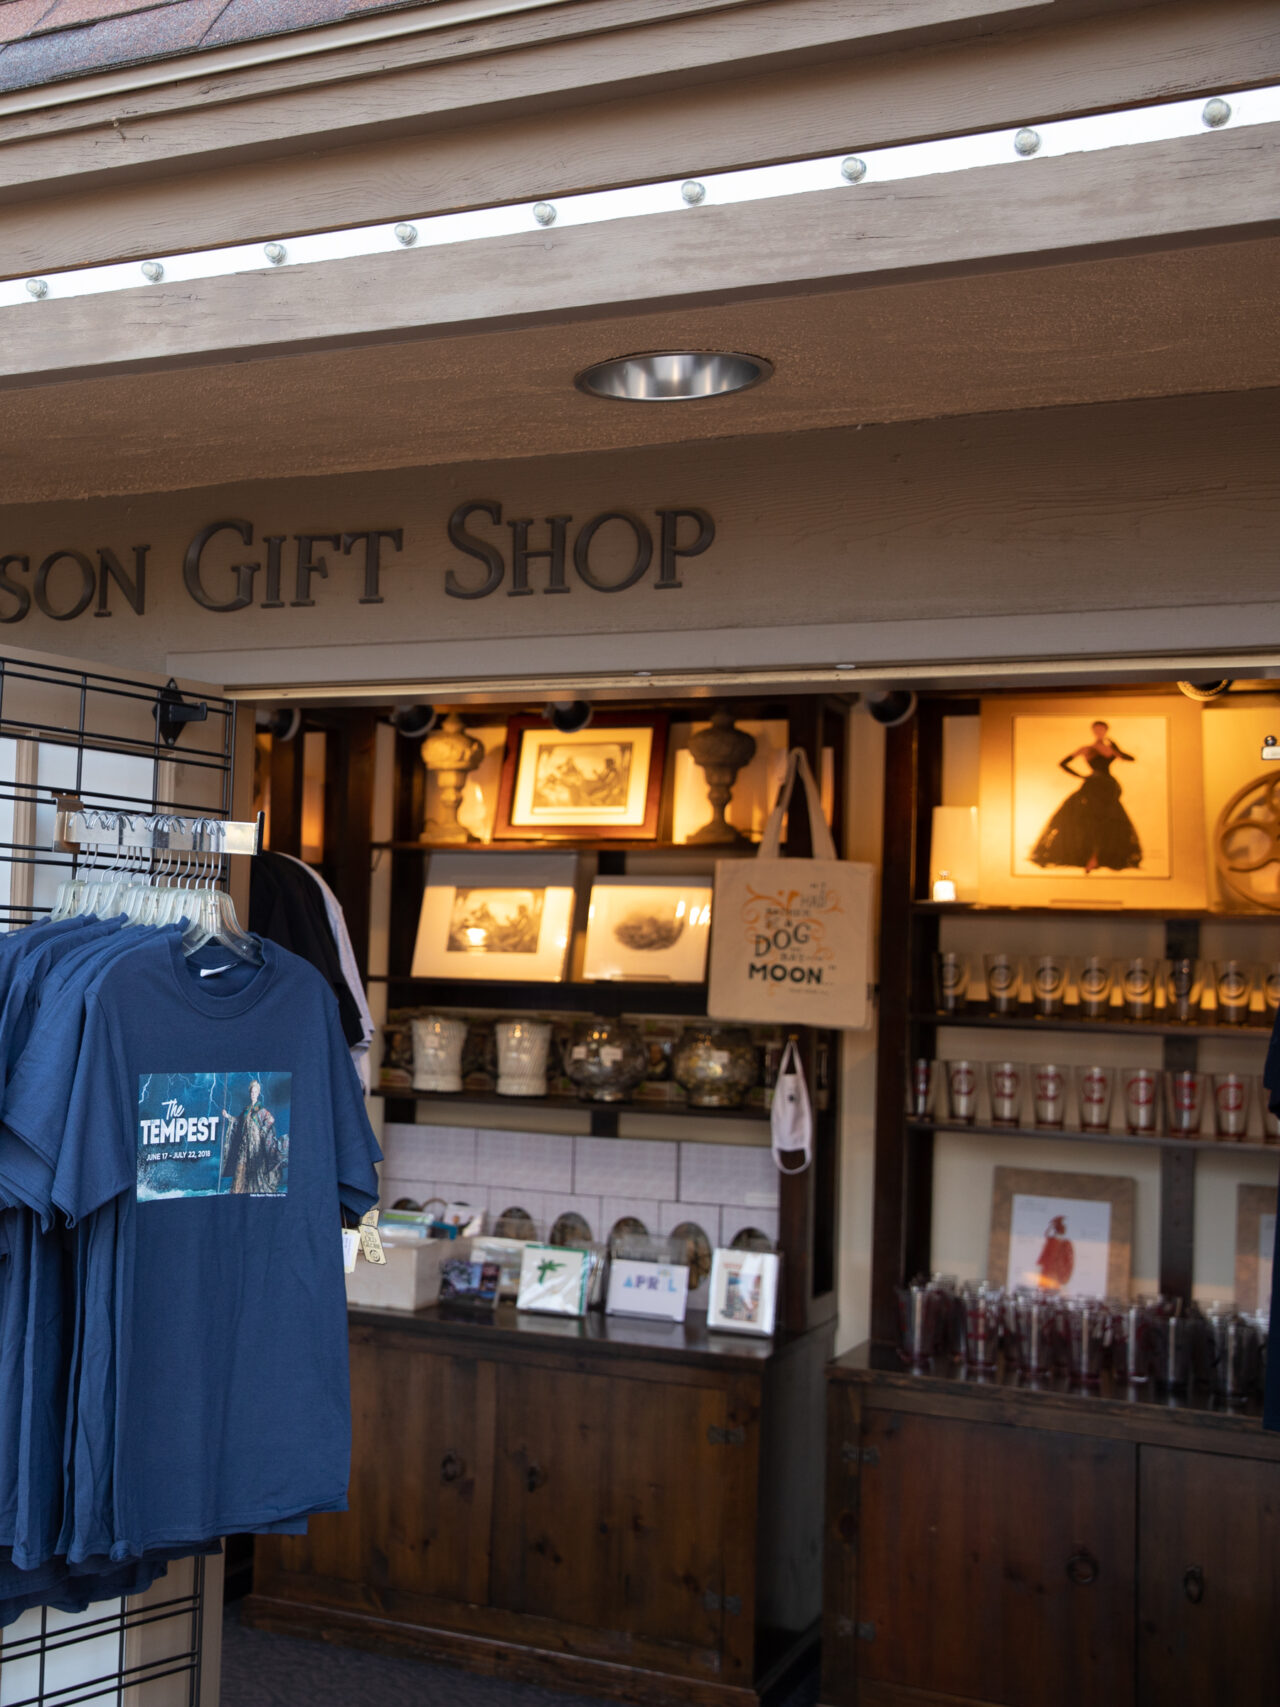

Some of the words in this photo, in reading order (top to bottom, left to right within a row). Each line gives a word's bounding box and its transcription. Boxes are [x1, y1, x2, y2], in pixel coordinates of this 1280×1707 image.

[183, 518, 403, 613] GIFT
[445, 499, 716, 600] SHOP
[755, 922, 811, 957] DOG
[748, 963, 823, 984] MOON
[162, 1098, 185, 1120] The
[140, 1116, 219, 1145] TEMPEST
[146, 1152, 161, 1161] JUNE
[162, 1152, 169, 1160] 17
[173, 1151, 187, 1160] JULY
[188, 1151, 197, 1160] 22,
[198, 1150, 211, 1158] 2018
